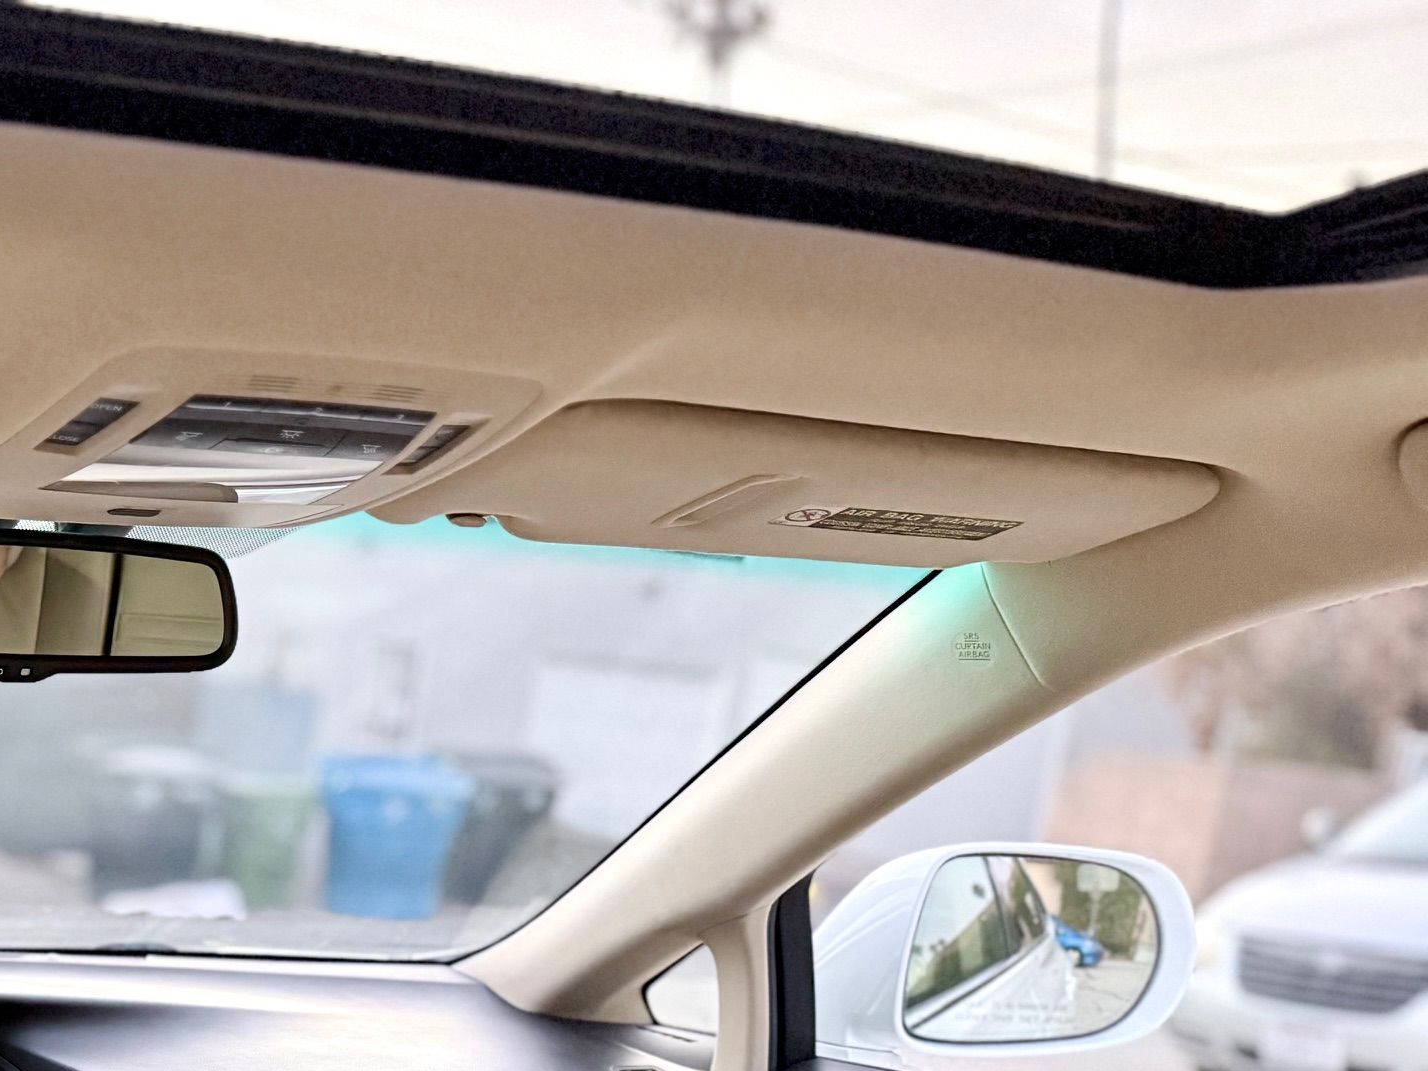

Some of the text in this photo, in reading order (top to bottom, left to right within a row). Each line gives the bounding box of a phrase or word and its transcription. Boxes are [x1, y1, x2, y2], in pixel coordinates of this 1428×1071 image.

[840, 509, 877, 517] AIR
[880, 511, 924, 521] BAG
[963, 632, 980, 640] SRS
[955, 642, 991, 650] CURTAIN
[958, 650, 990, 658] AIRBAG
